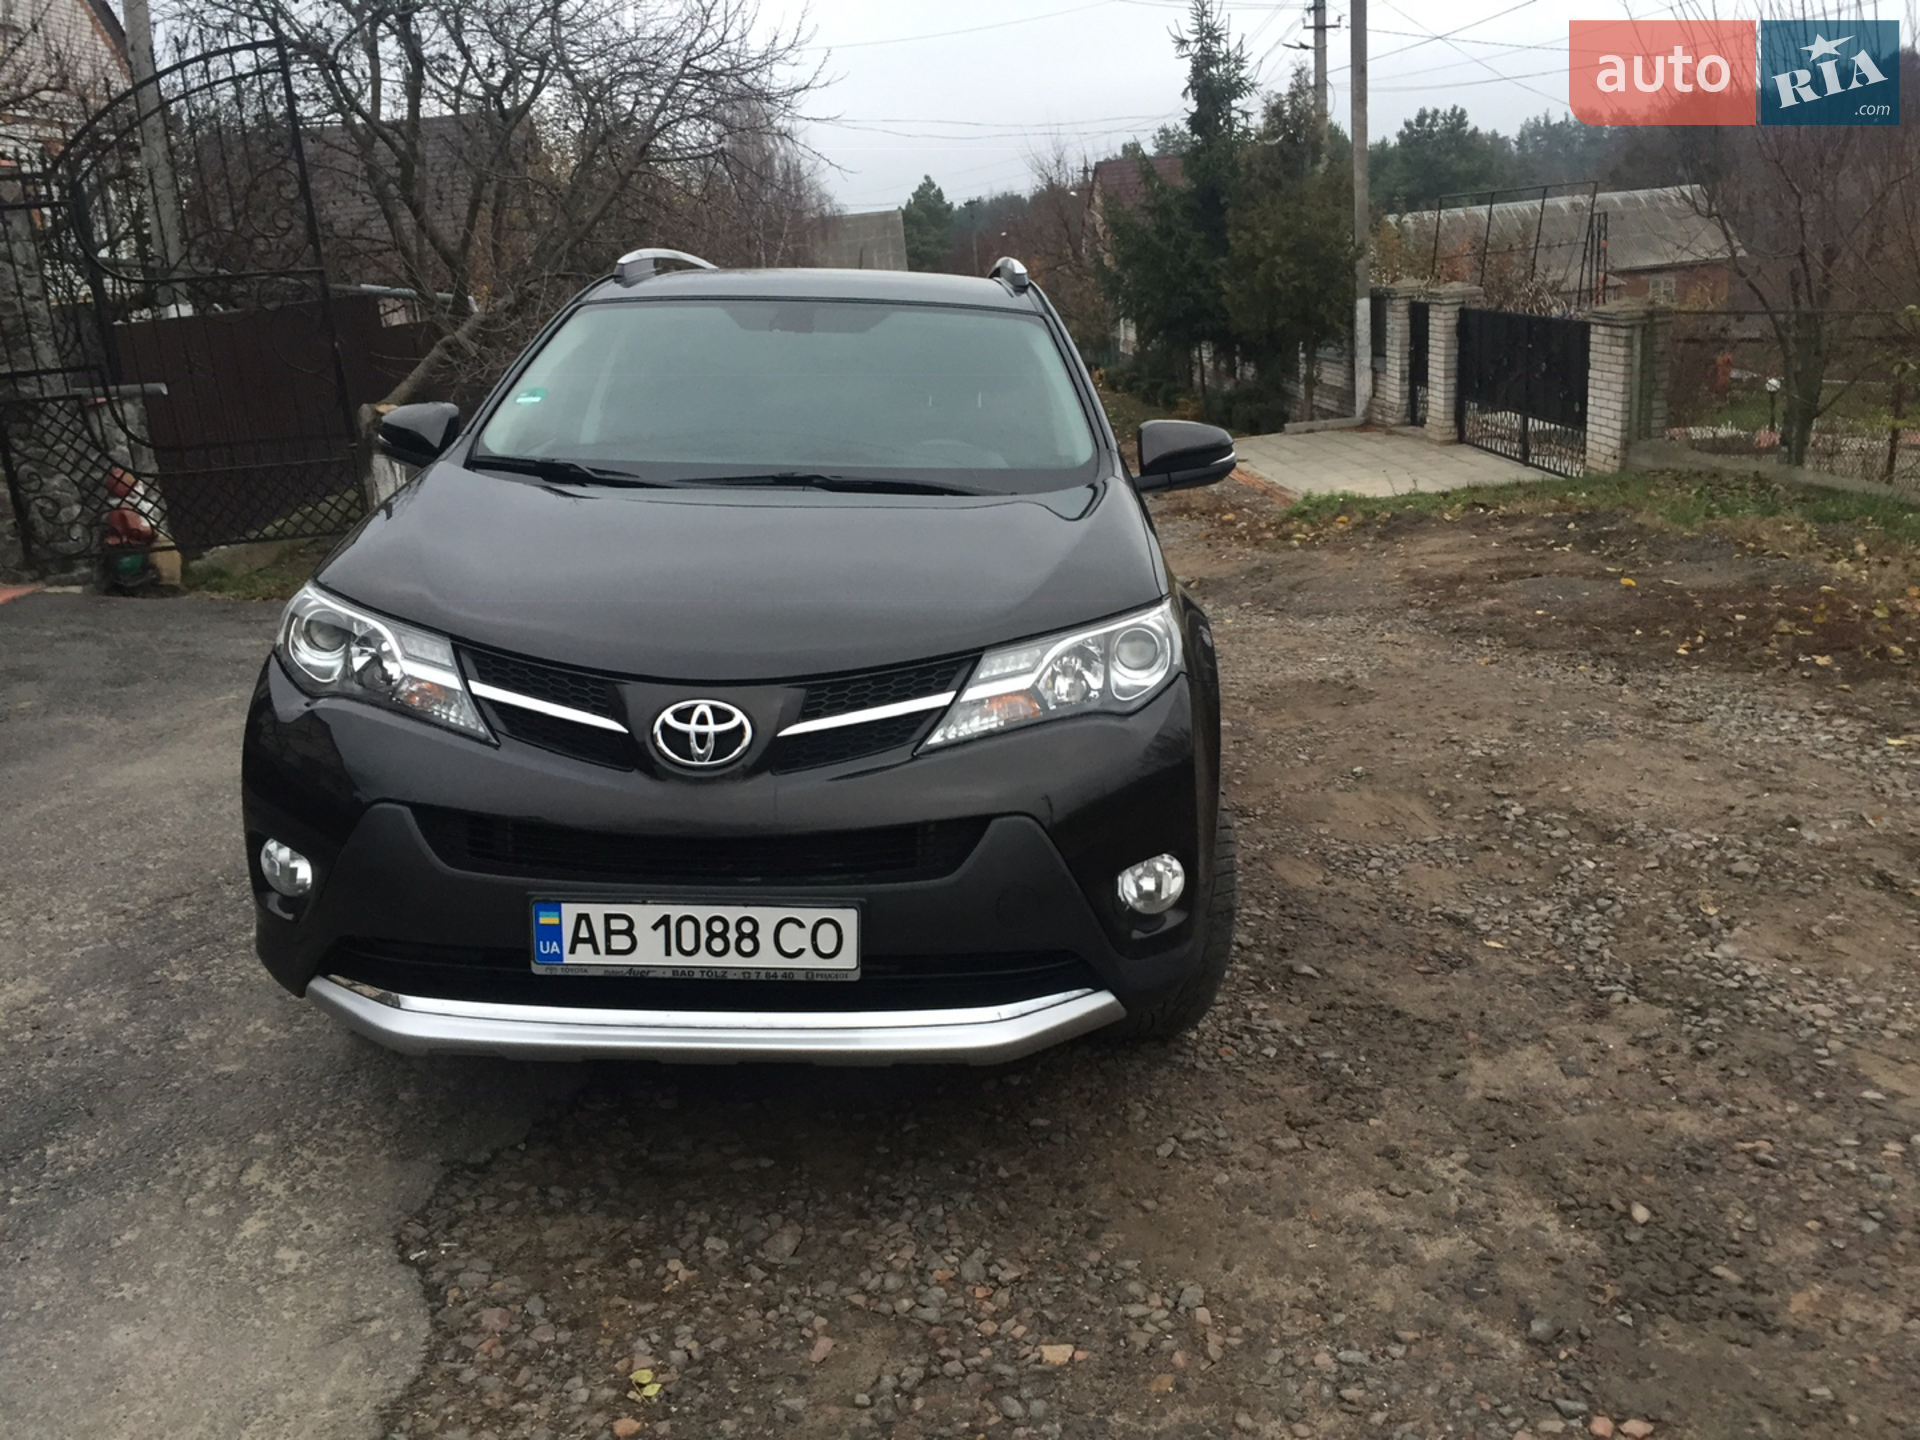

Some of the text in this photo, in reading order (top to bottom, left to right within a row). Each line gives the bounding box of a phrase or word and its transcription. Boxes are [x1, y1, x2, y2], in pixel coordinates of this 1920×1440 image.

[568, 912, 844, 960] AB 1088 CO
[539, 941, 561, 955] UA
[671, 969, 695, 977] BAD
[754, 971, 762, 979] 7
[781, 972, 795, 980] 40
